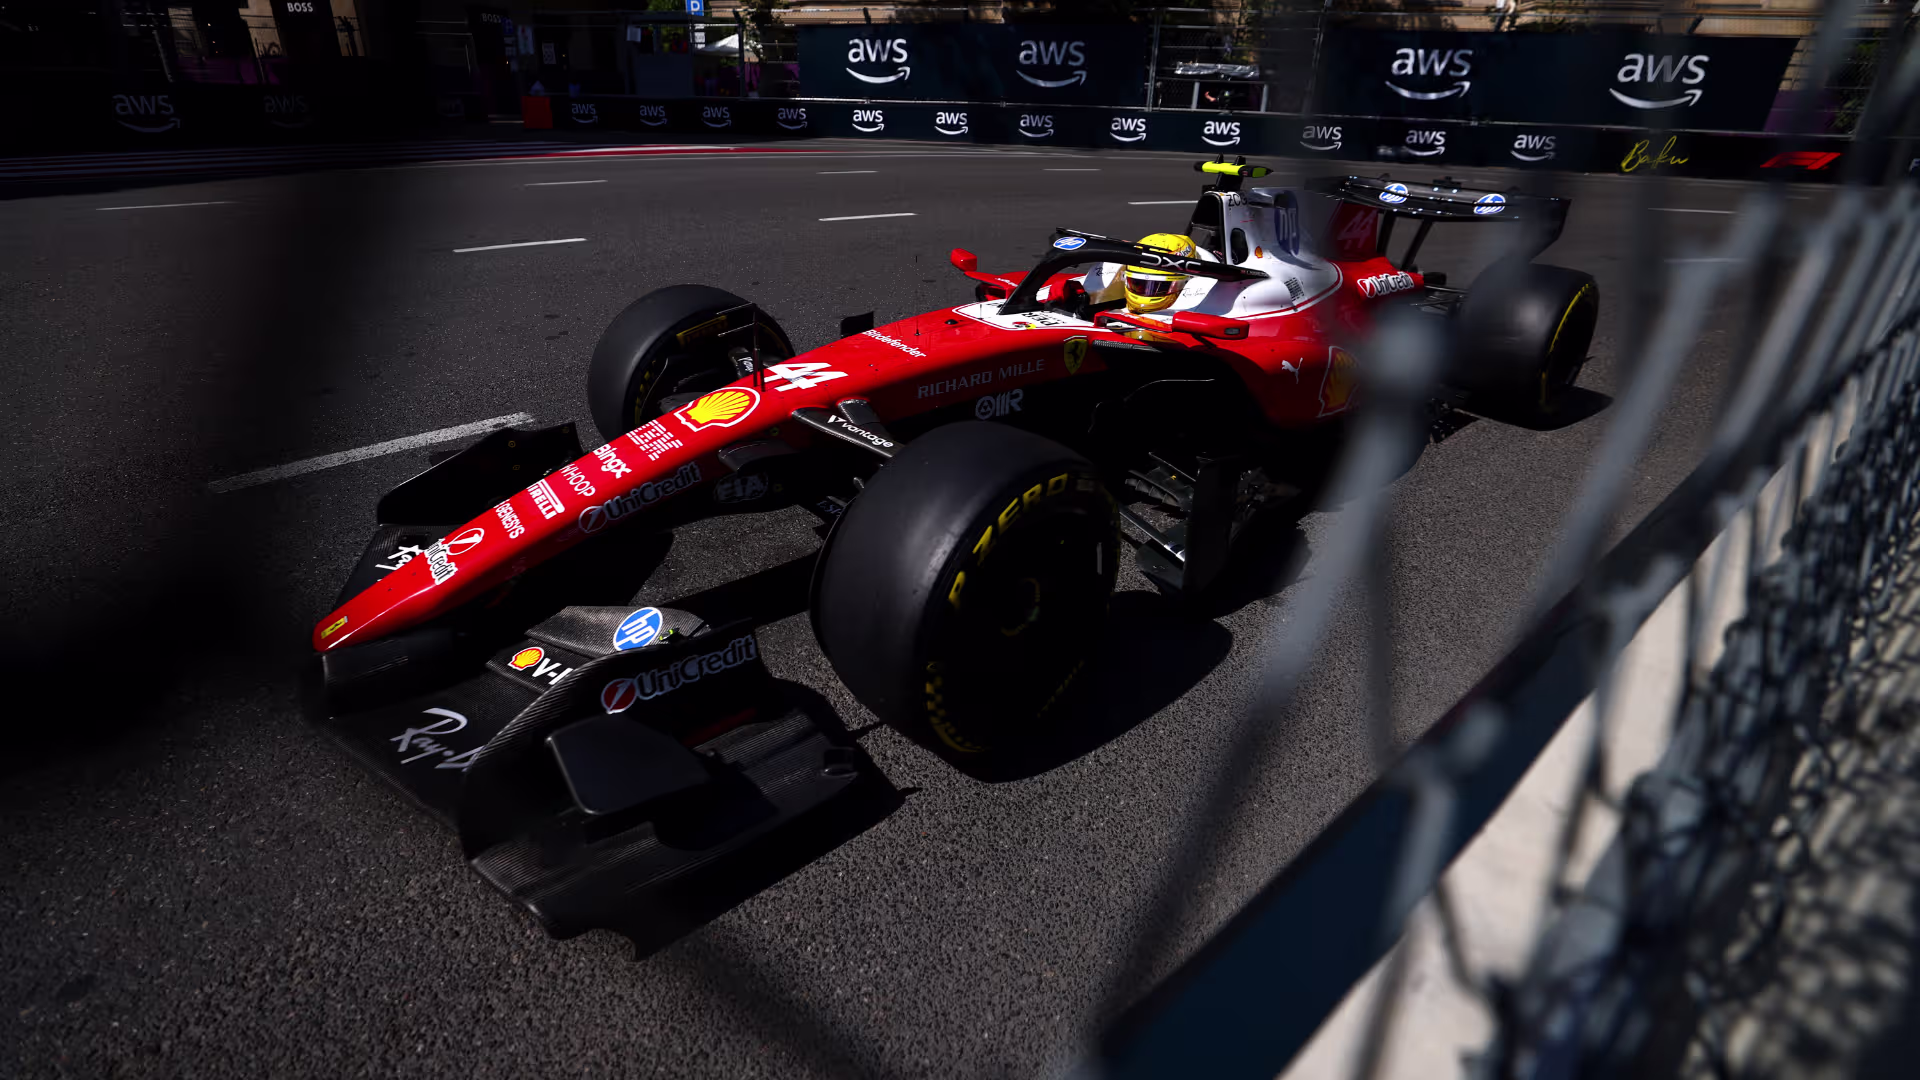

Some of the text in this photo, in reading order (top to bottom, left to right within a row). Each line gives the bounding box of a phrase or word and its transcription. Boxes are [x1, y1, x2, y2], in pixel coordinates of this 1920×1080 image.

[287, 2, 313, 12] BOSS
[847, 38, 908, 63] aws
[1018, 39, 1086, 66] aws
[1391, 47, 1474, 77] aws
[1616, 52, 1710, 85] aws
[112, 94, 174, 115] aws
[571, 103, 596, 115] aws
[639, 104, 666, 117] aws
[702, 105, 730, 119] aws
[777, 107, 807, 120] aws
[852, 108, 884, 123] aws
[935, 111, 968, 125] aws
[1019, 113, 1054, 130] aws
[1111, 117, 1147, 131] aws
[1203, 120, 1241, 136] aws
[1302, 125, 1343, 140] aws
[1405, 129, 1447, 146] aws
[1513, 133, 1556, 151] aws
[1620, 136, 1689, 173] Baku
[1140, 252, 1201, 272] DXC
[1372, 270, 1415, 296] UniCredit
[863, 329, 927, 358] Bitdefender
[764, 362, 849, 393] 44
[917, 358, 1047, 399] RICHARD MILLE
[625, 418, 684, 461] IBM
[841, 421, 895, 448] vantage
[560, 463, 596, 497] WHOOP
[603, 463, 701, 520] UniCredit
[716, 474, 765, 500] FIA
[526, 478, 566, 520] PIRELLI
[496, 501, 526, 539] GENESYS
[973, 473, 1069, 568] ZERO
[424, 538, 459, 585] niCredit
[615, 608, 660, 650] hp
[636, 634, 758, 700] UniCredit
